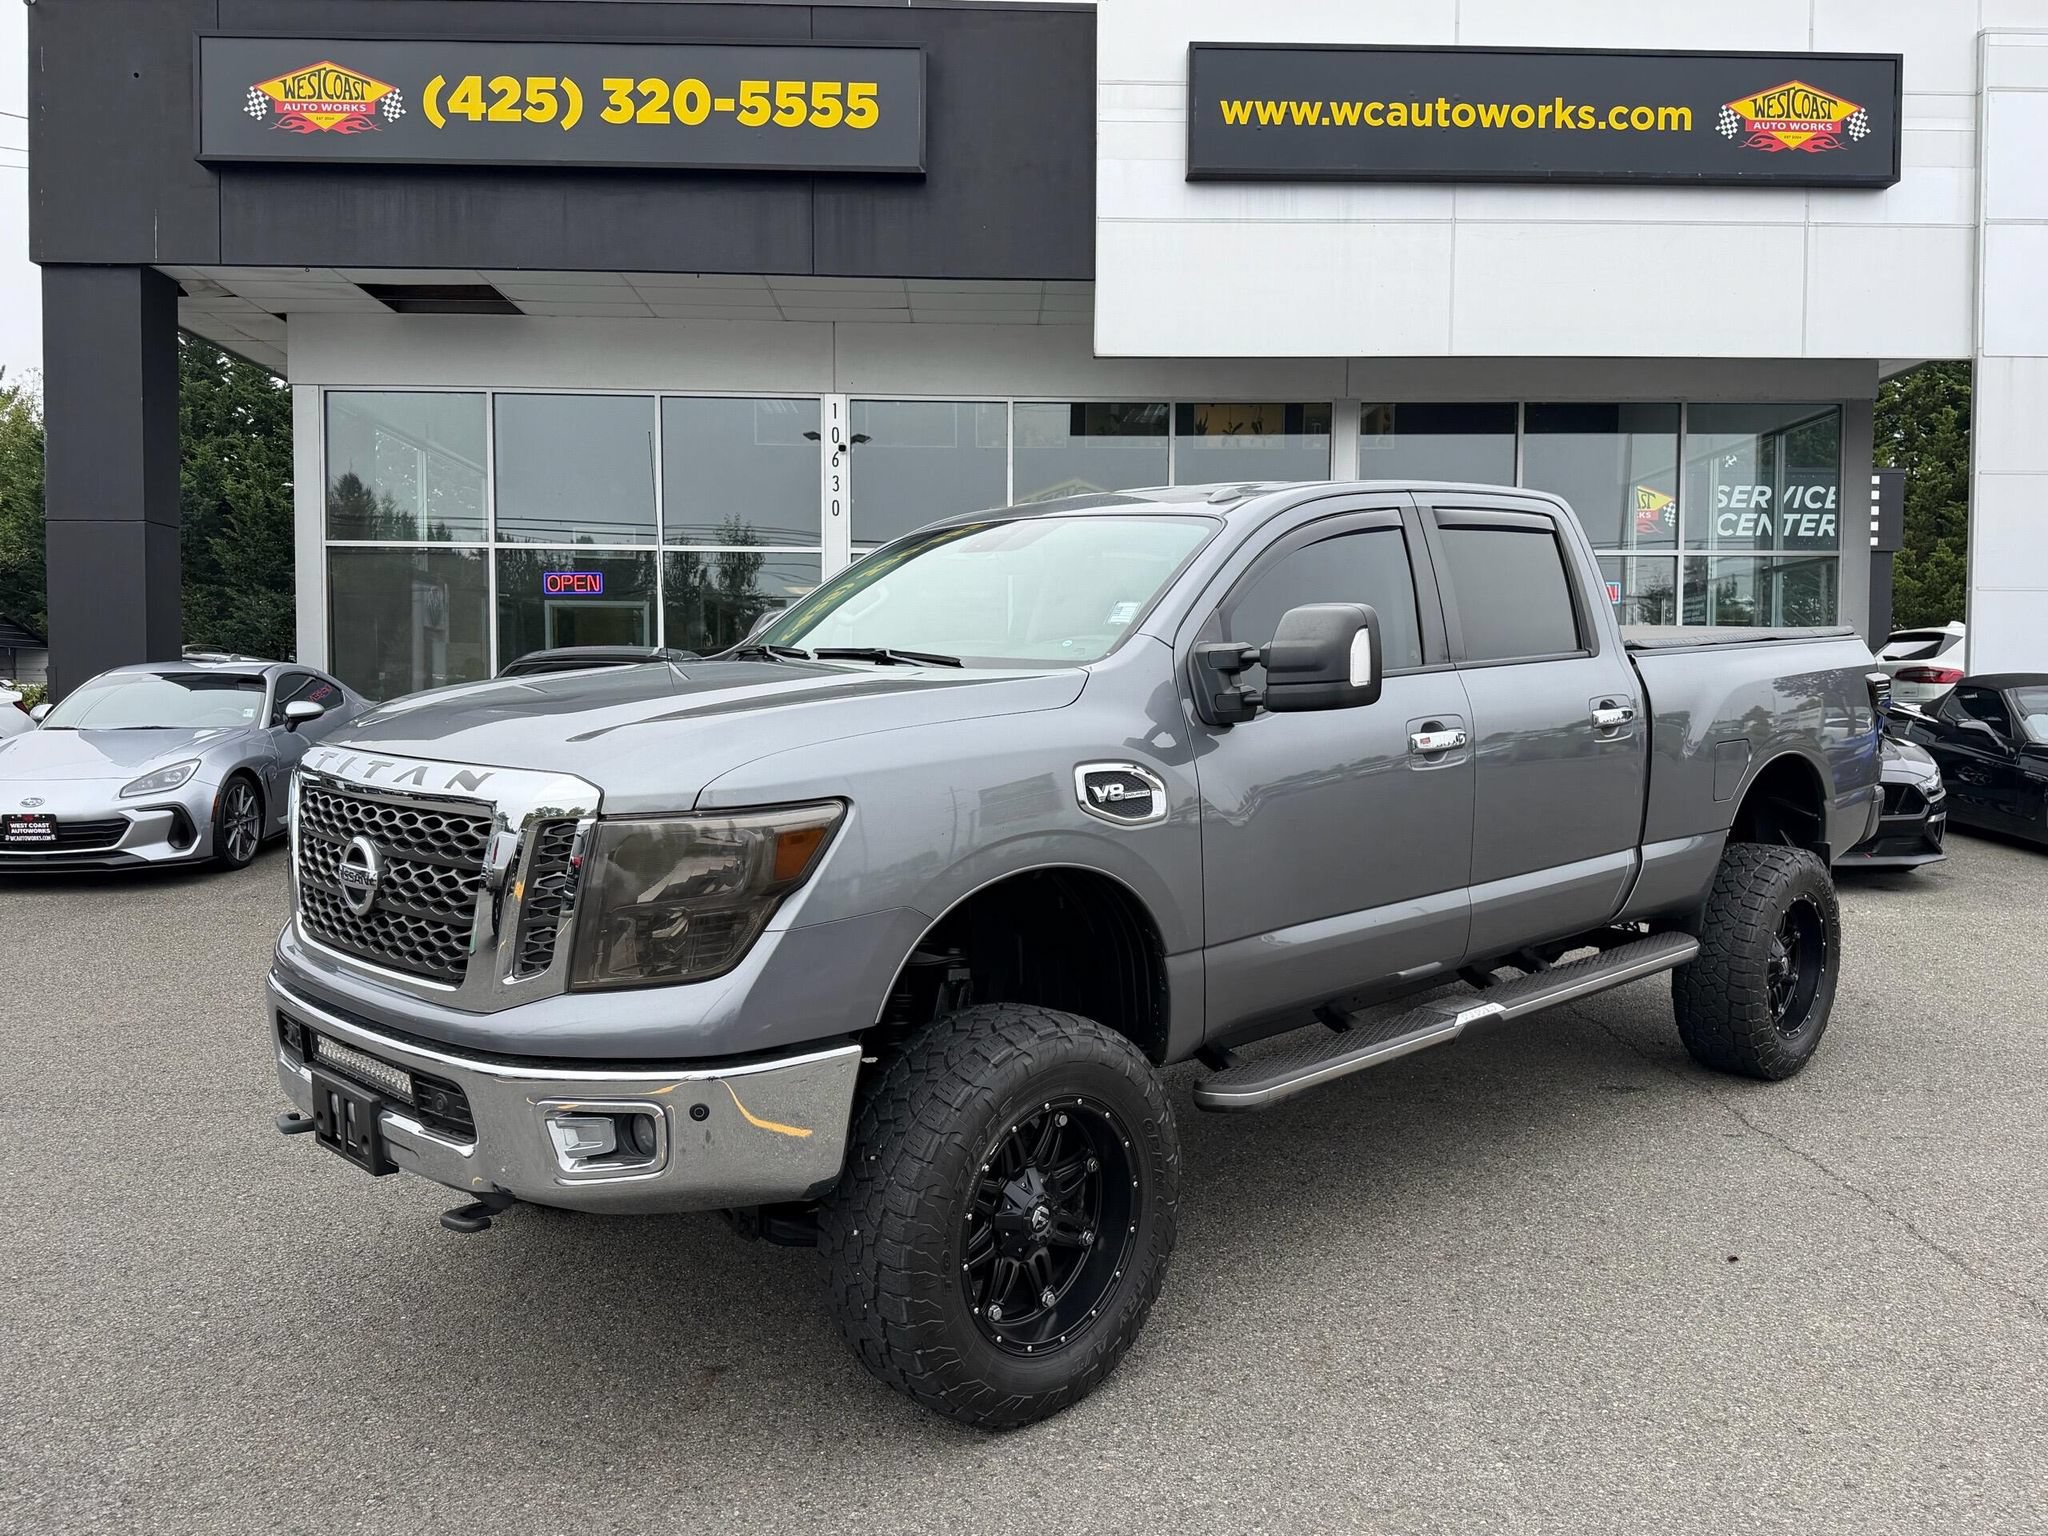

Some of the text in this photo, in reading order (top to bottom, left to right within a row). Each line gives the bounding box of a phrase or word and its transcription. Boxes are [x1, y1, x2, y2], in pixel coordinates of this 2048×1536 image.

[283, 103, 367, 112] AUTO WORKS
[422, 75, 879, 132] (425) 320-5555
[1219, 97, 1693, 132] www.wcautoworks.com
[1753, 121, 1833, 132] AUTO WORKS
[831, 402, 840, 516] 10630
[1717, 512, 1836, 537] CENTER
[547, 575, 600, 592] OPEN
[315, 751, 495, 792] TITAN
[1088, 783, 1124, 803] V8
